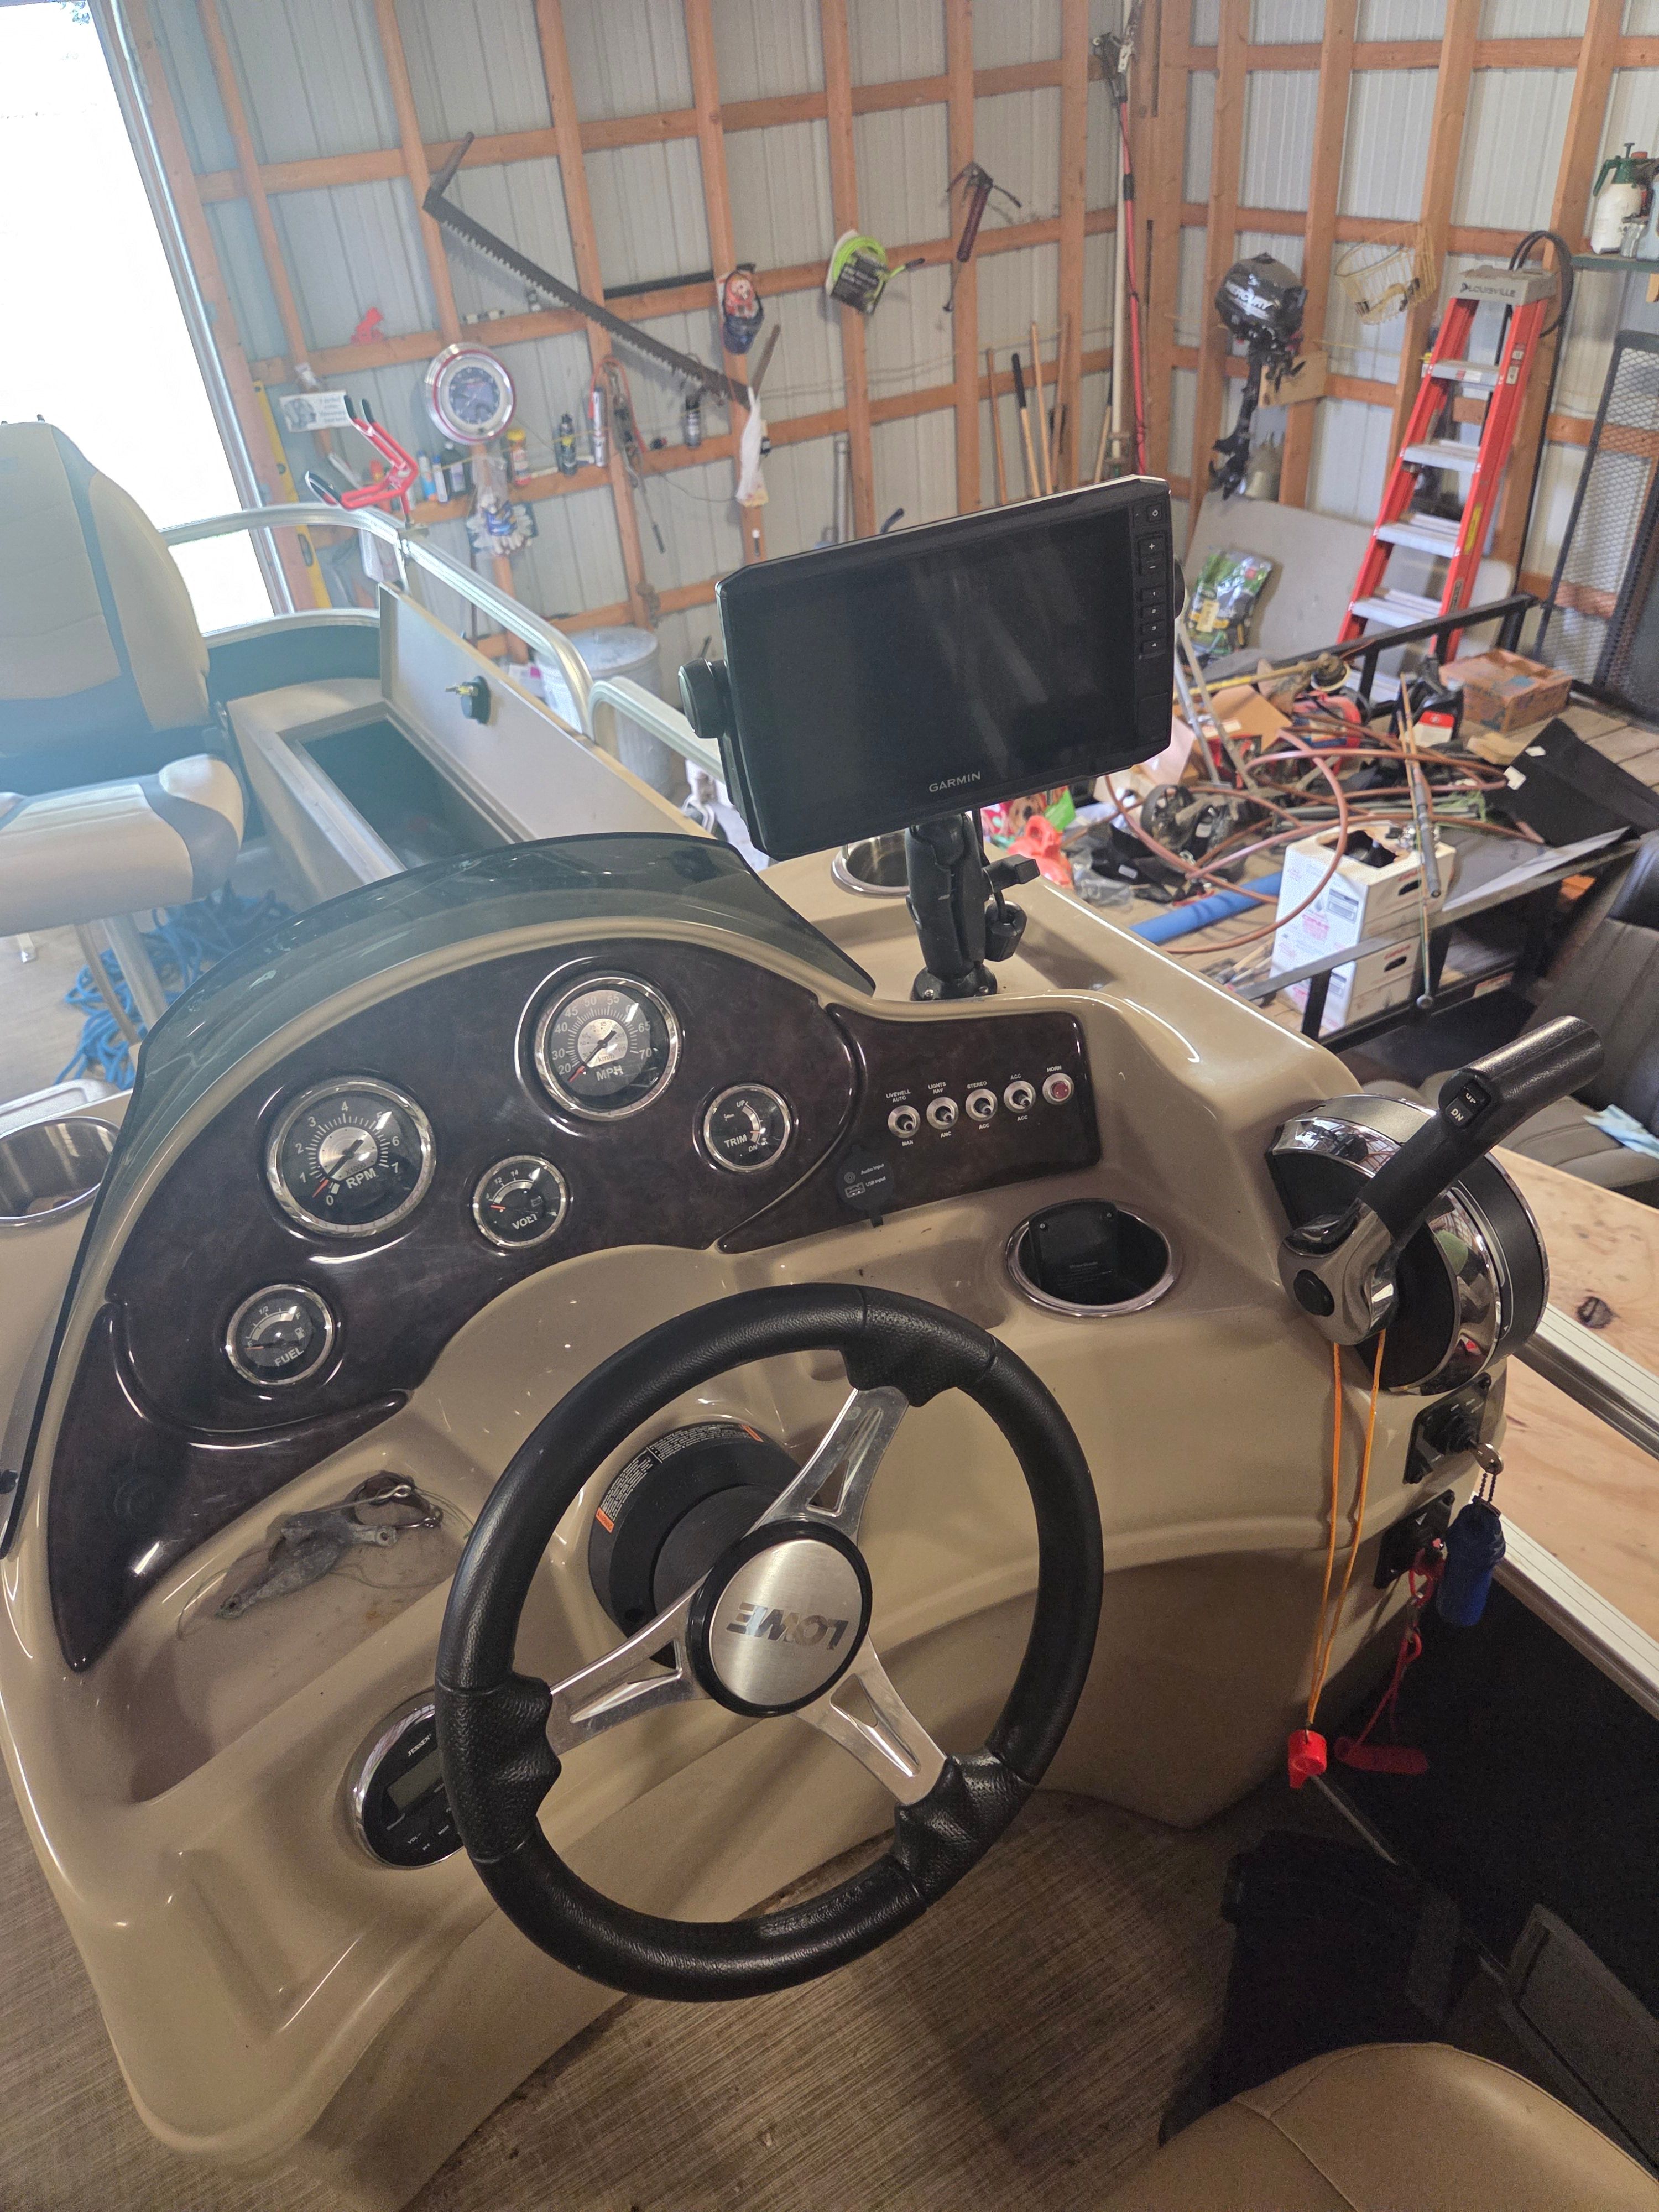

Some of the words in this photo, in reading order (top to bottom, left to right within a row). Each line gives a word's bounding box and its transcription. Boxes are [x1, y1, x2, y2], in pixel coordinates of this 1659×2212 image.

[928, 770, 982, 792] GARMIN
[584, 996, 597, 1008] 50
[607, 995, 620, 1005] 55
[564, 1007, 578, 1018] 45
[554, 1022, 568, 1034] 40
[638, 1021, 651, 1032] 65
[552, 1048, 565, 1060] 30
[639, 1048, 652, 1060] 70
[558, 1063, 571, 1076] 20
[596, 1065, 624, 1081] MPH
[927, 1081, 947, 1089] LIGHTS
[967, 1081, 987, 1089] STEREO
[885, 1089, 911, 1099] LIVEWELL
[1465, 1092, 1477, 1104] UP
[341, 1101, 349, 1112] 4
[736, 1099, 745, 1108] UP
[1450, 1108, 1464, 1123] DN
[308, 1116, 316, 1127] 3
[392, 1136, 400, 1146] 6
[724, 1134, 748, 1148] TRIM
[295, 1143, 304, 1154] 2
[748, 1144, 758, 1152] DN
[392, 1162, 399, 1173] 7
[299, 1172, 307, 1183] 1
[345, 1168, 377, 1189] RPM
[326, 1194, 334, 1206] 0
[512, 1213, 538, 1230] VOLT
[296, 1312, 301, 1320] F
[274, 1347, 304, 1367] FUEL
[726, 1601, 849, 1650] LOWE
